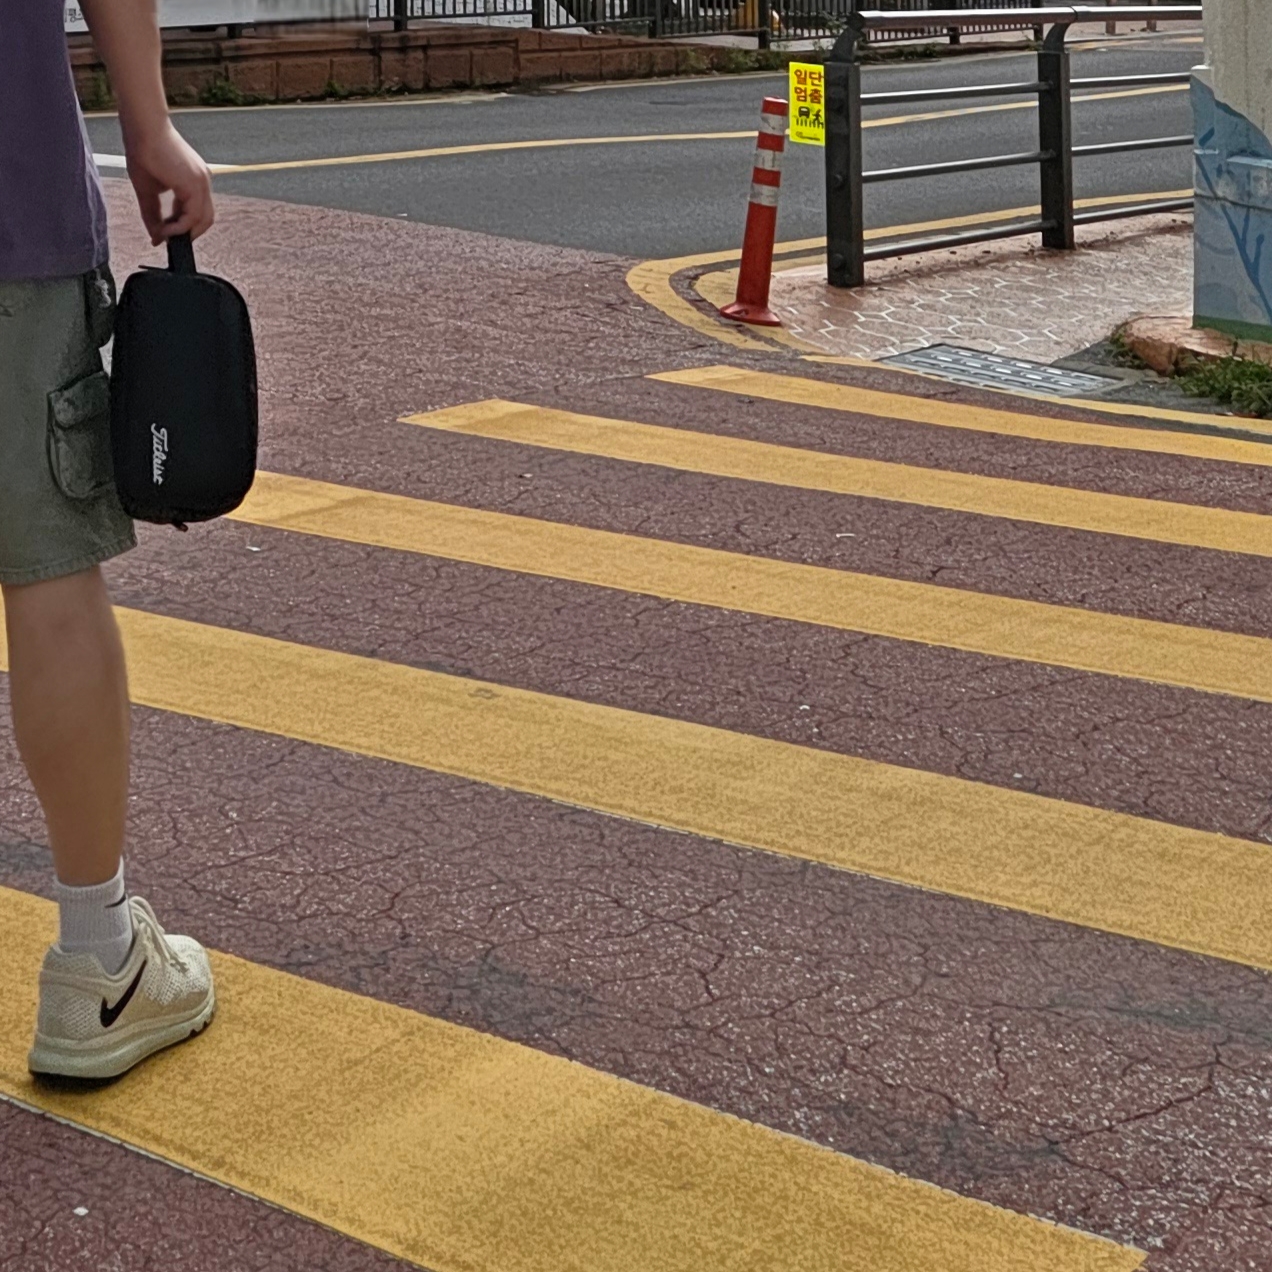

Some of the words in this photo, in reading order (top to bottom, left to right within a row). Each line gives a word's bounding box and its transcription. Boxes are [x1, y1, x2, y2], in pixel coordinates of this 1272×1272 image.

[794, 69, 824, 87] 일단
[794, 87, 823, 105] 멈춤
[150, 423, 168, 486] Titleist
